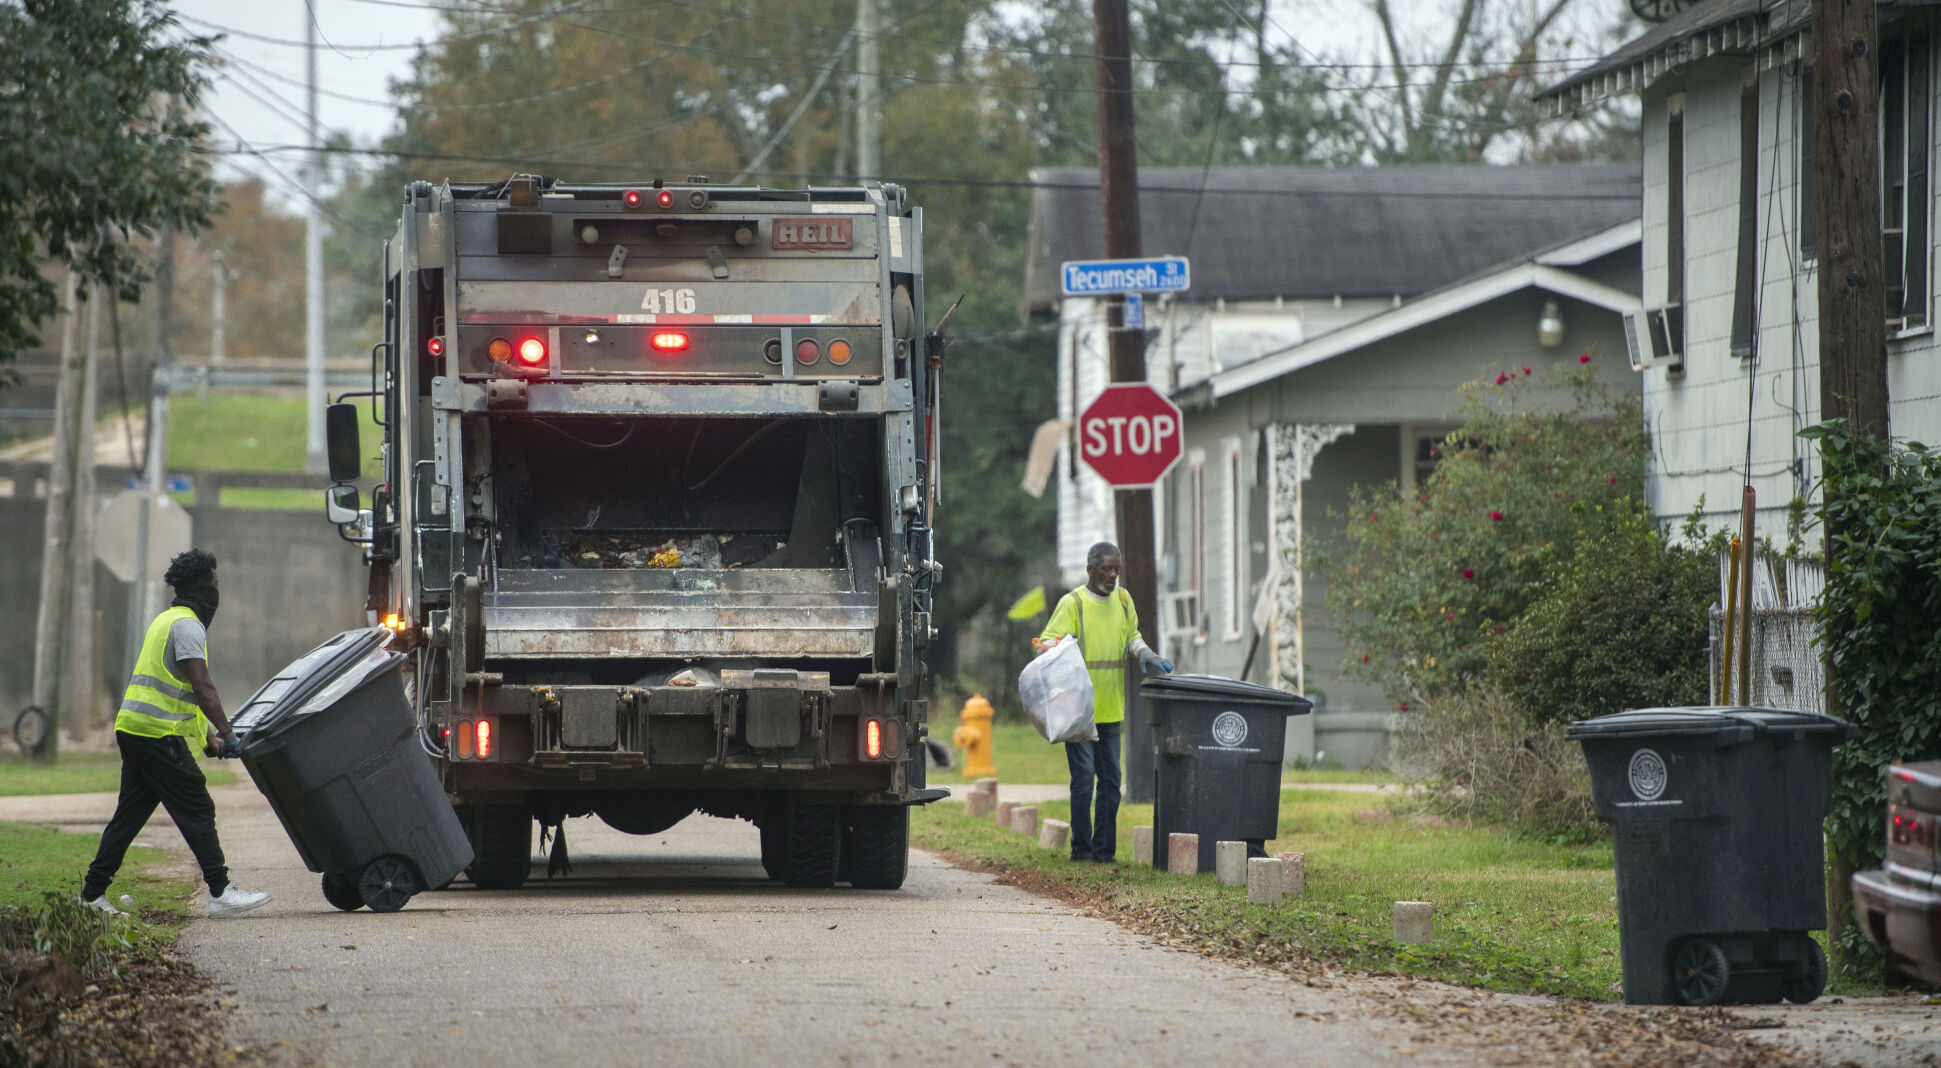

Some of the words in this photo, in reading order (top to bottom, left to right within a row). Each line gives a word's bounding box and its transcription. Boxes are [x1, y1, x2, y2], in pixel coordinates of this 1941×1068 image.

[778, 223, 847, 244] HEIL
[1068, 263, 1157, 290] Tecumseh
[1165, 262, 1178, 276] St
[641, 288, 696, 314] 416
[1085, 415, 1175, 457] STOP
